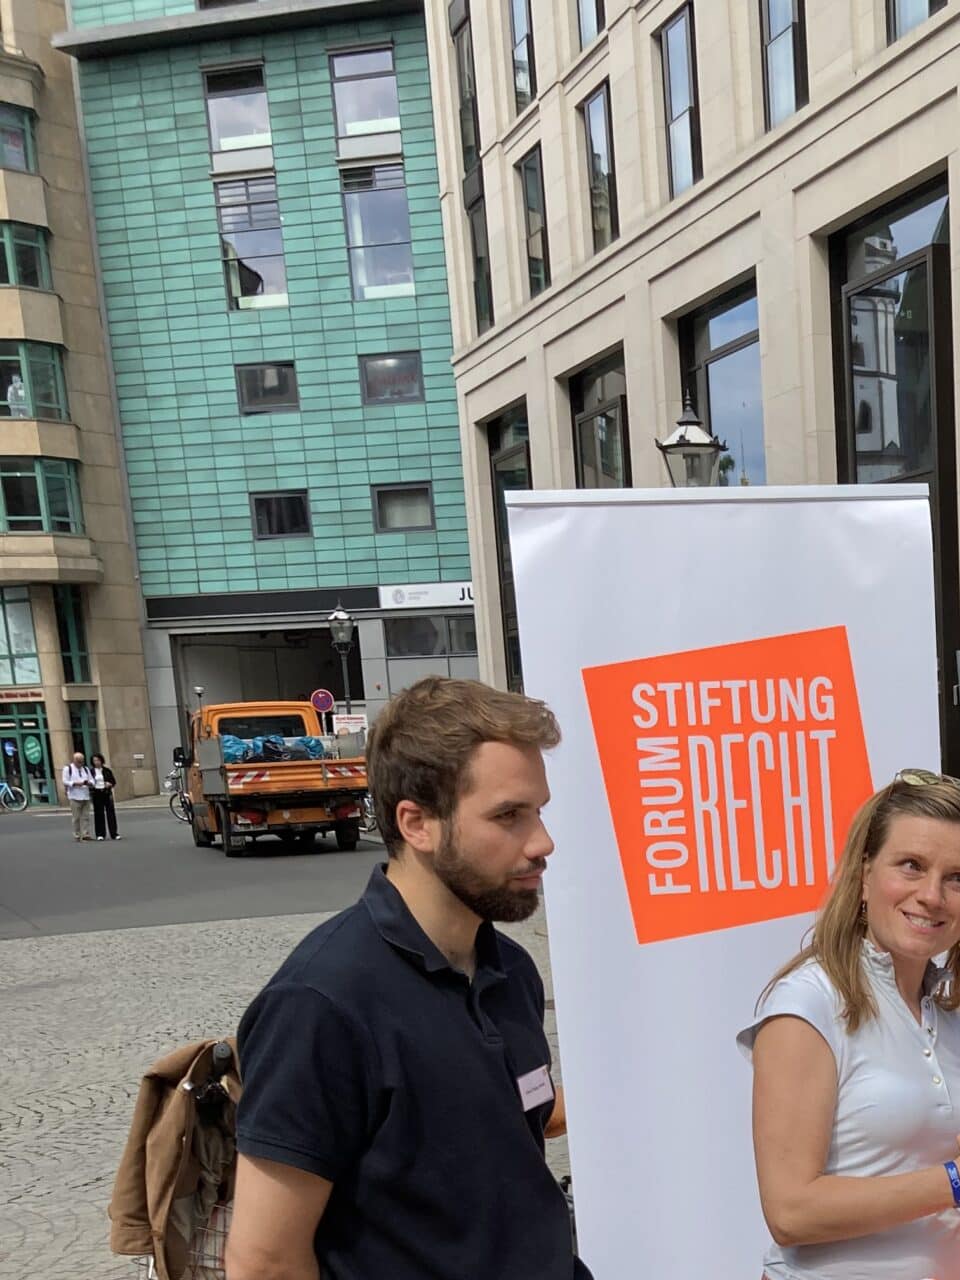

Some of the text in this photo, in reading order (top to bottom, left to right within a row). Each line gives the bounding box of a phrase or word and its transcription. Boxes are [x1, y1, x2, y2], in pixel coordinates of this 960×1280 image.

[632, 676, 835, 729] STIFTUNG
[636, 735, 692, 896] FORUM
[687, 729, 837, 893] RECHT
